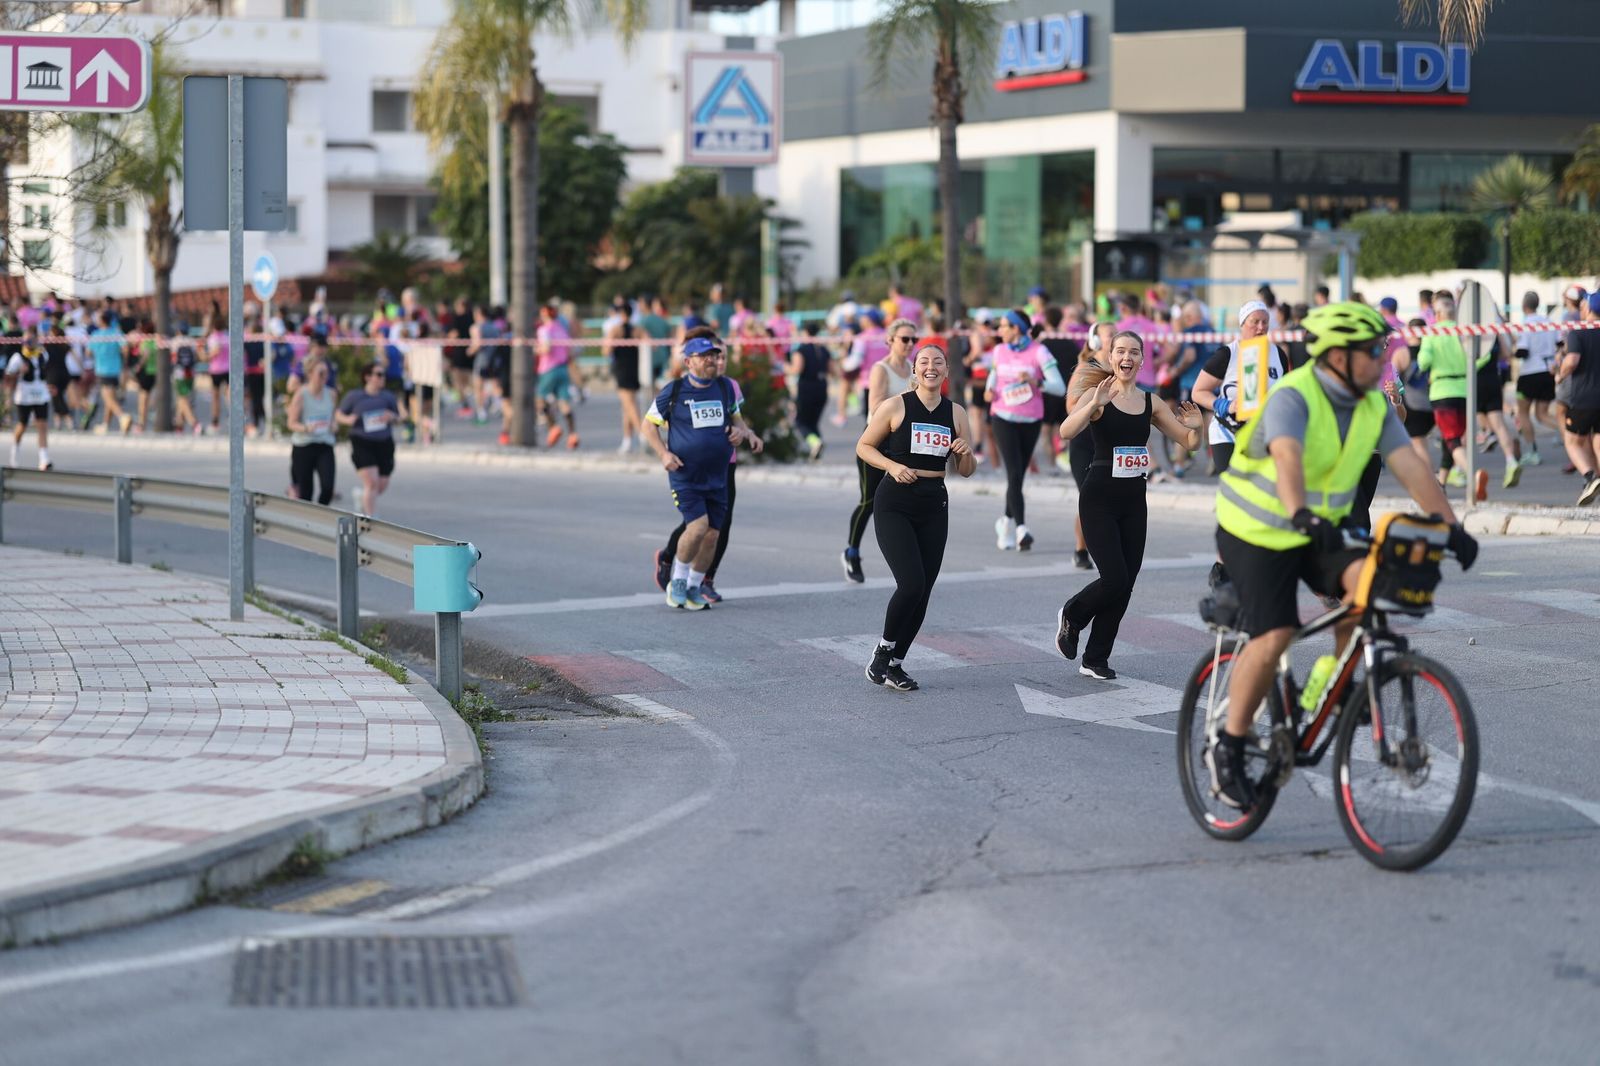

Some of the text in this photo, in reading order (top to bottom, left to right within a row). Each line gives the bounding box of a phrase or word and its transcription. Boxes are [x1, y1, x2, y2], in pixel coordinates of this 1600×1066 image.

[995, 10, 1087, 77] ALDI
[1296, 39, 1470, 93] ALDI
[700, 131, 764, 151] ALDI
[694, 408, 722, 419] 1536
[914, 431, 950, 447] 1135
[1116, 455, 1149, 468] 1643
